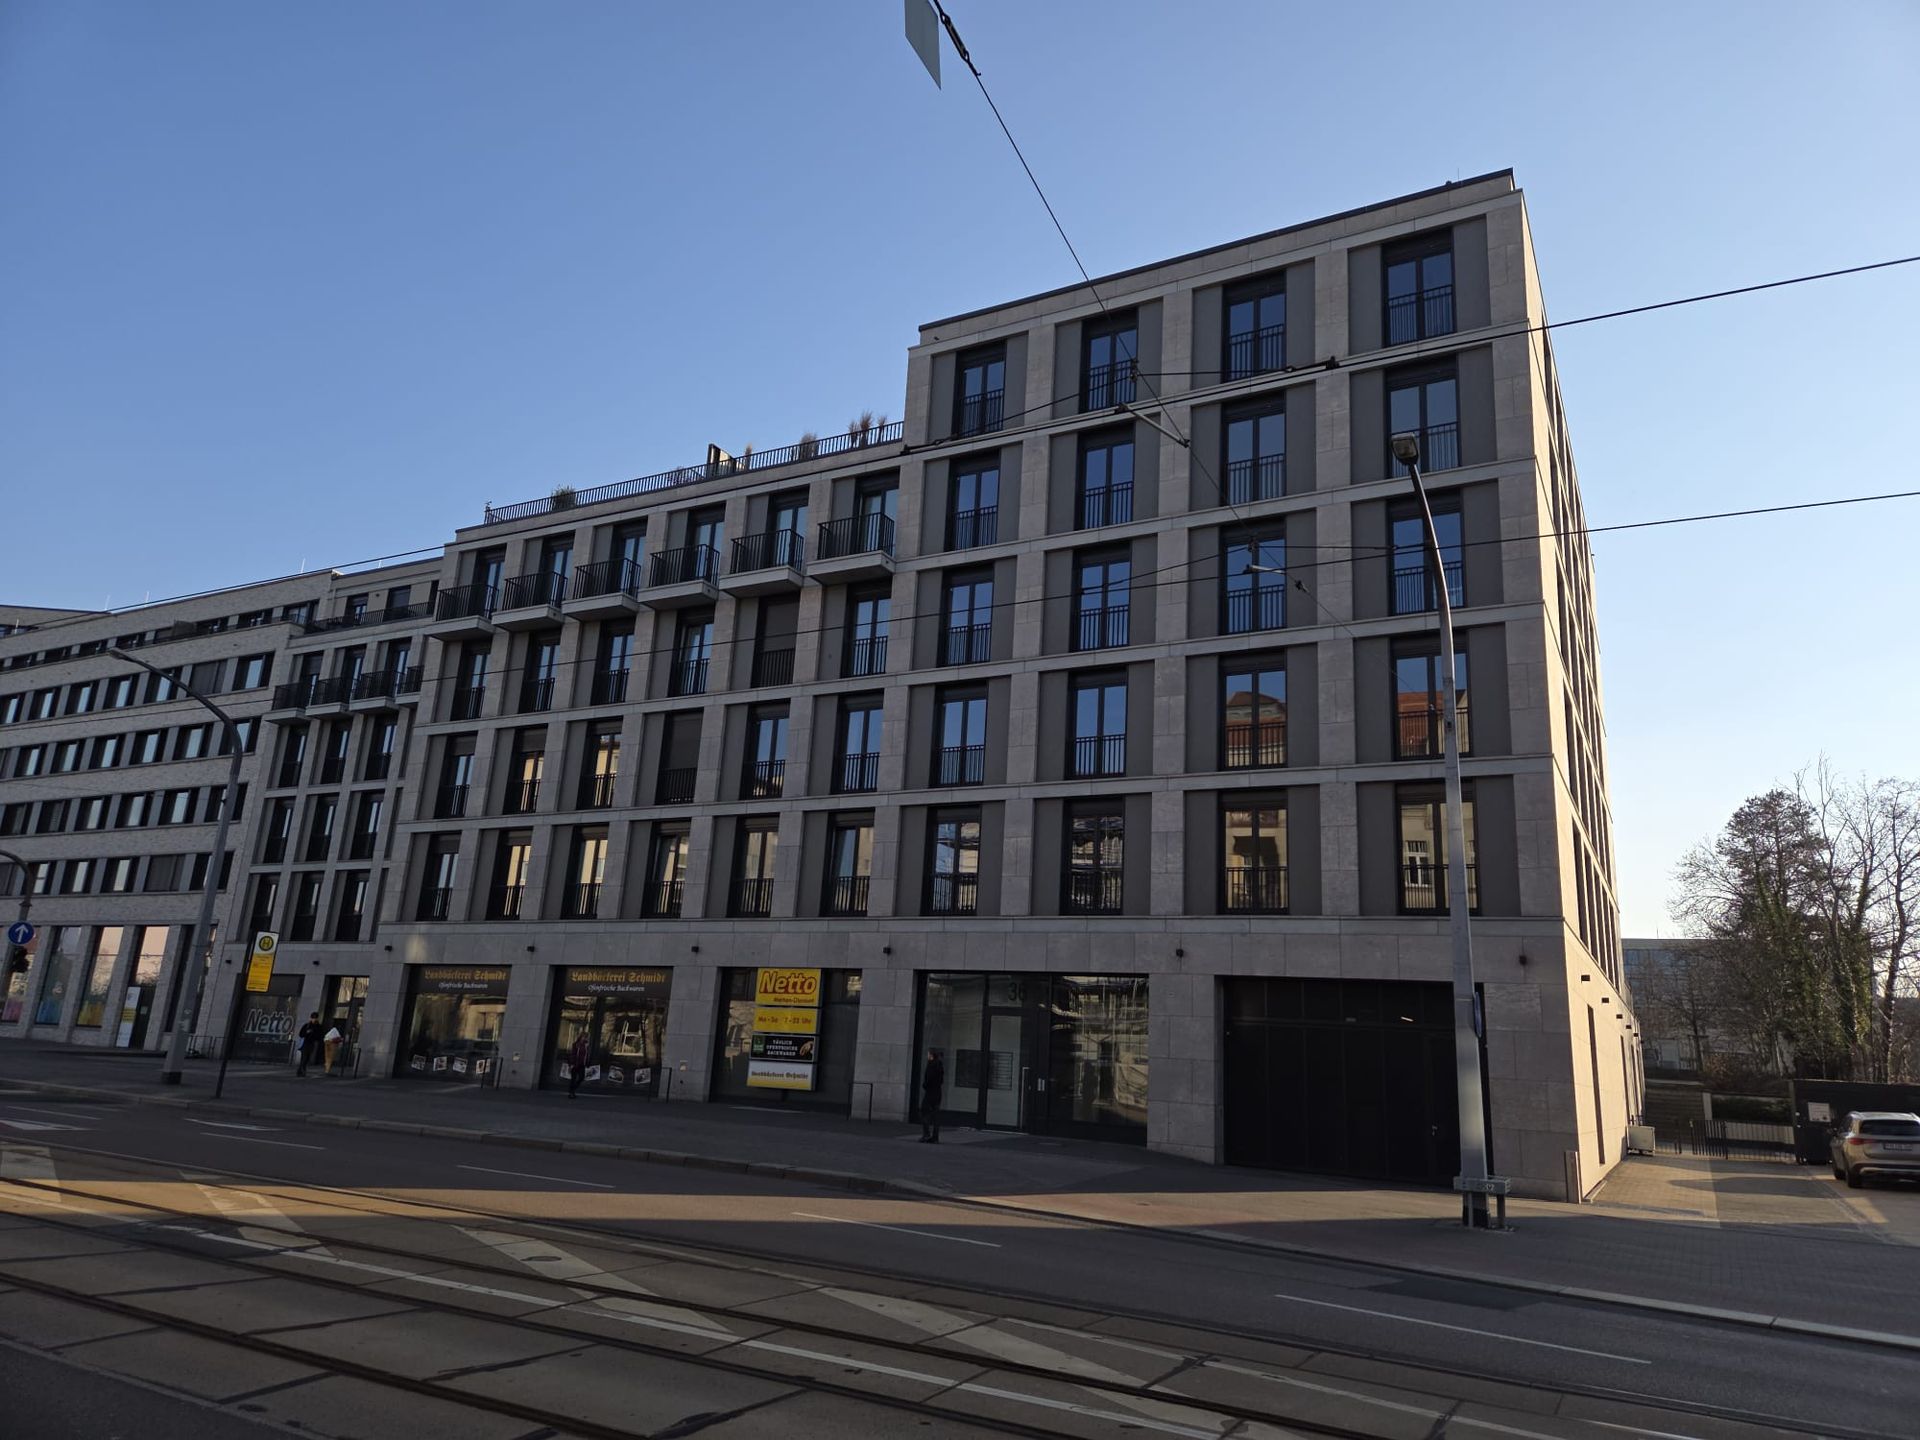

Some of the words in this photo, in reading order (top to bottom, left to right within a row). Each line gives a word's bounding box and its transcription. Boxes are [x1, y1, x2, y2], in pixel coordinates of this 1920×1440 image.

[627, 970, 666, 984] Schmidt
[759, 971, 817, 994] Netto
[244, 1008, 294, 1034] Netto
